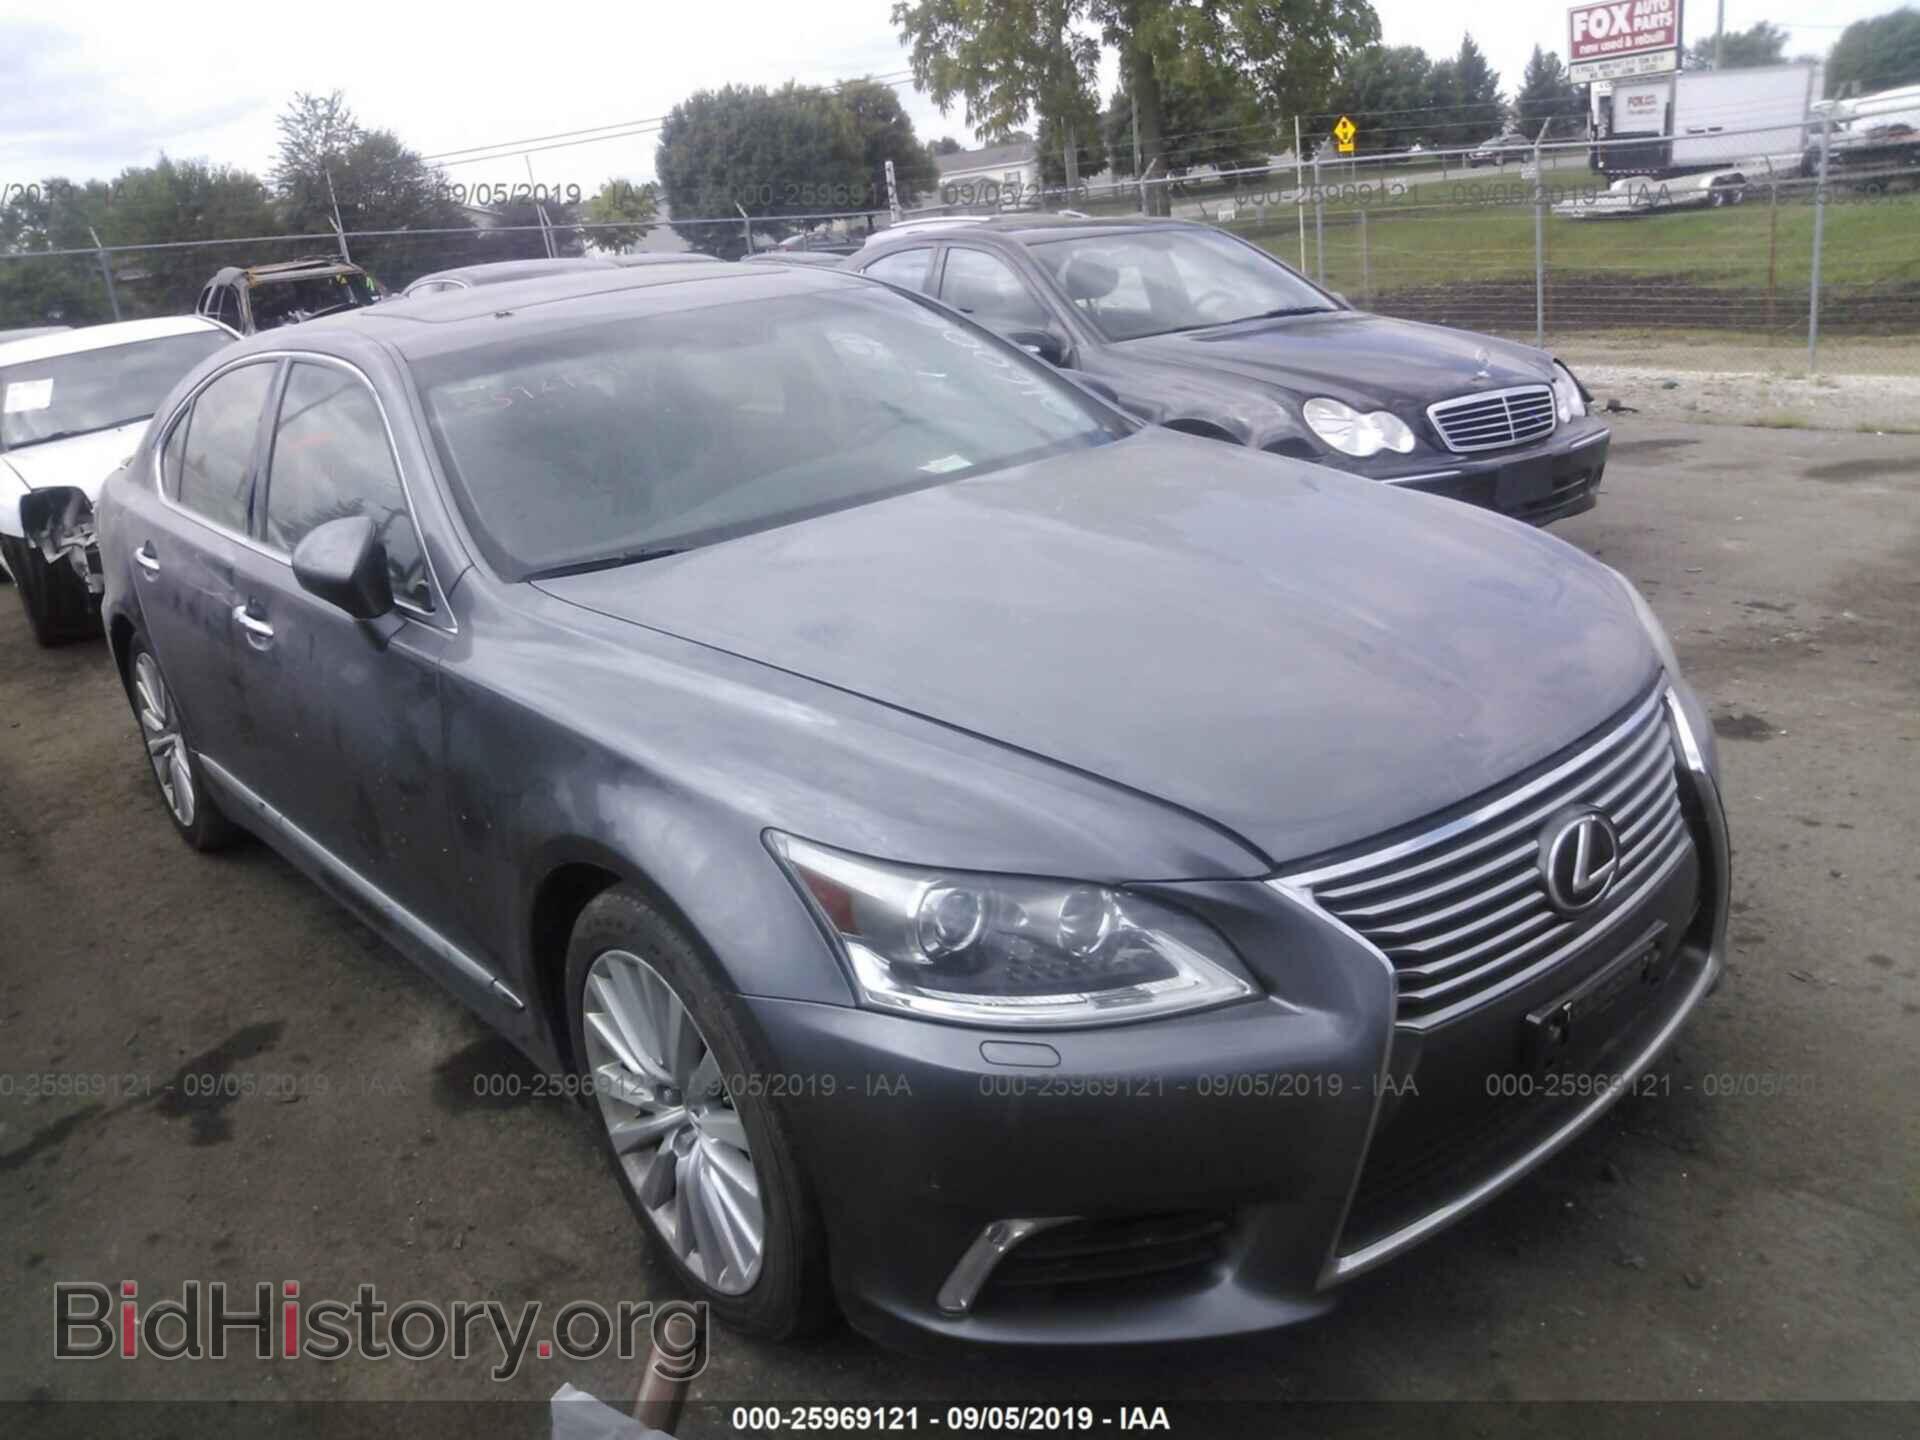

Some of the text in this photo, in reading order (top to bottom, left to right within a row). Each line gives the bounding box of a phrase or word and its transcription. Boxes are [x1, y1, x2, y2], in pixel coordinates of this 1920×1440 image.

[1633, 0, 1670, 16] AUTO
[1573, 3, 1632, 42] FOX
[1633, 10, 1673, 32] PARTS
